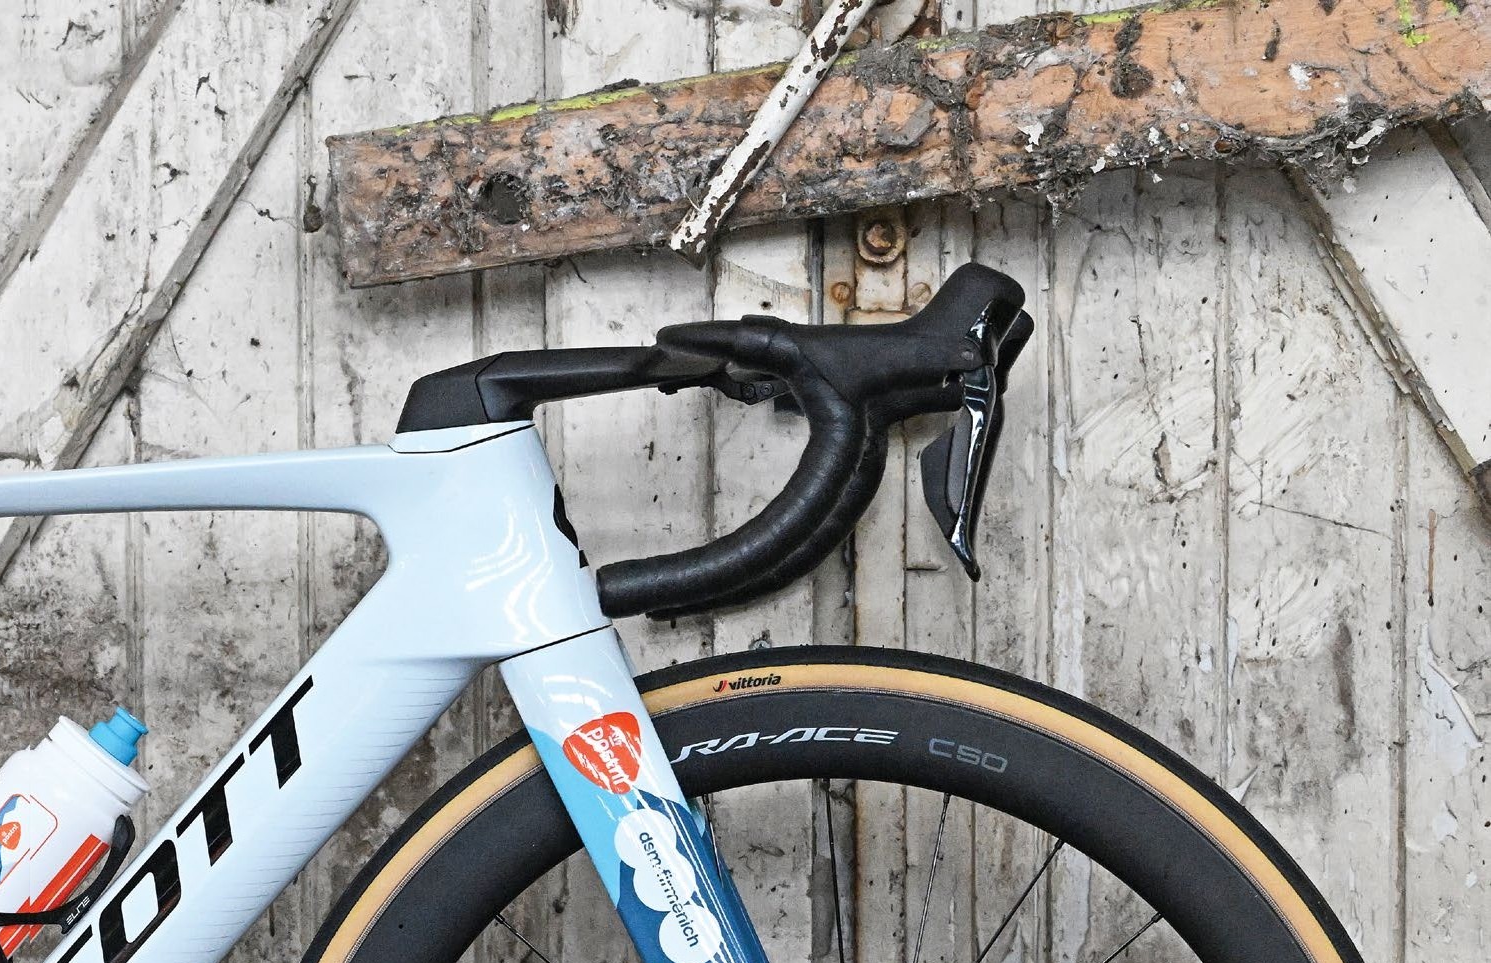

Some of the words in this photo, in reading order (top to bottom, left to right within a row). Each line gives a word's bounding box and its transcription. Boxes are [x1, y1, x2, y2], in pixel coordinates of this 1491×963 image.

[727, 673, 782, 691] vittoria
[670, 726, 899, 765] RA-ACE
[928, 737, 1008, 774] C50
[0, 823, 19, 844] postnl
[65, 896, 91, 926] ELITE
